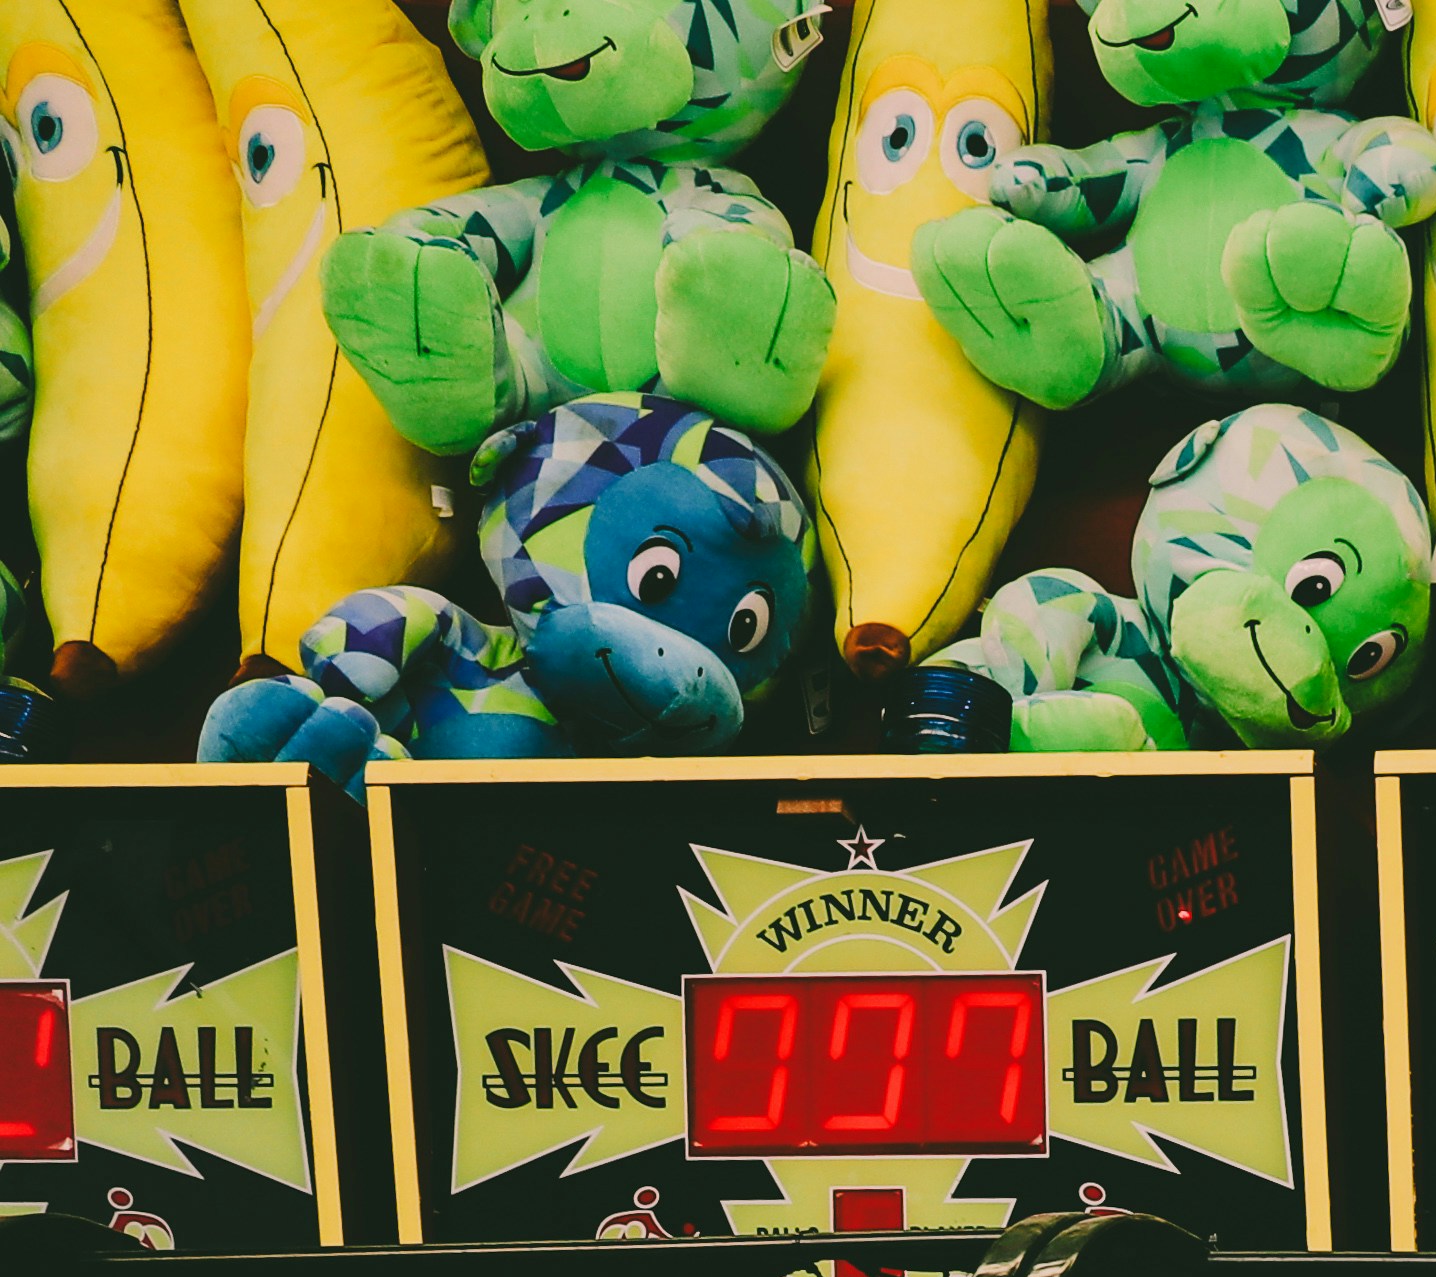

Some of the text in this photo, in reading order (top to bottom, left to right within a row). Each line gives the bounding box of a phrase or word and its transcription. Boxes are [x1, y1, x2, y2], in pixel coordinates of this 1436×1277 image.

[756, 888, 966, 955] WINNER
[88, 1026, 274, 1109] BALL
[483, 1026, 667, 1110] SKEE
[1063, 1017, 1256, 1105] BALL
